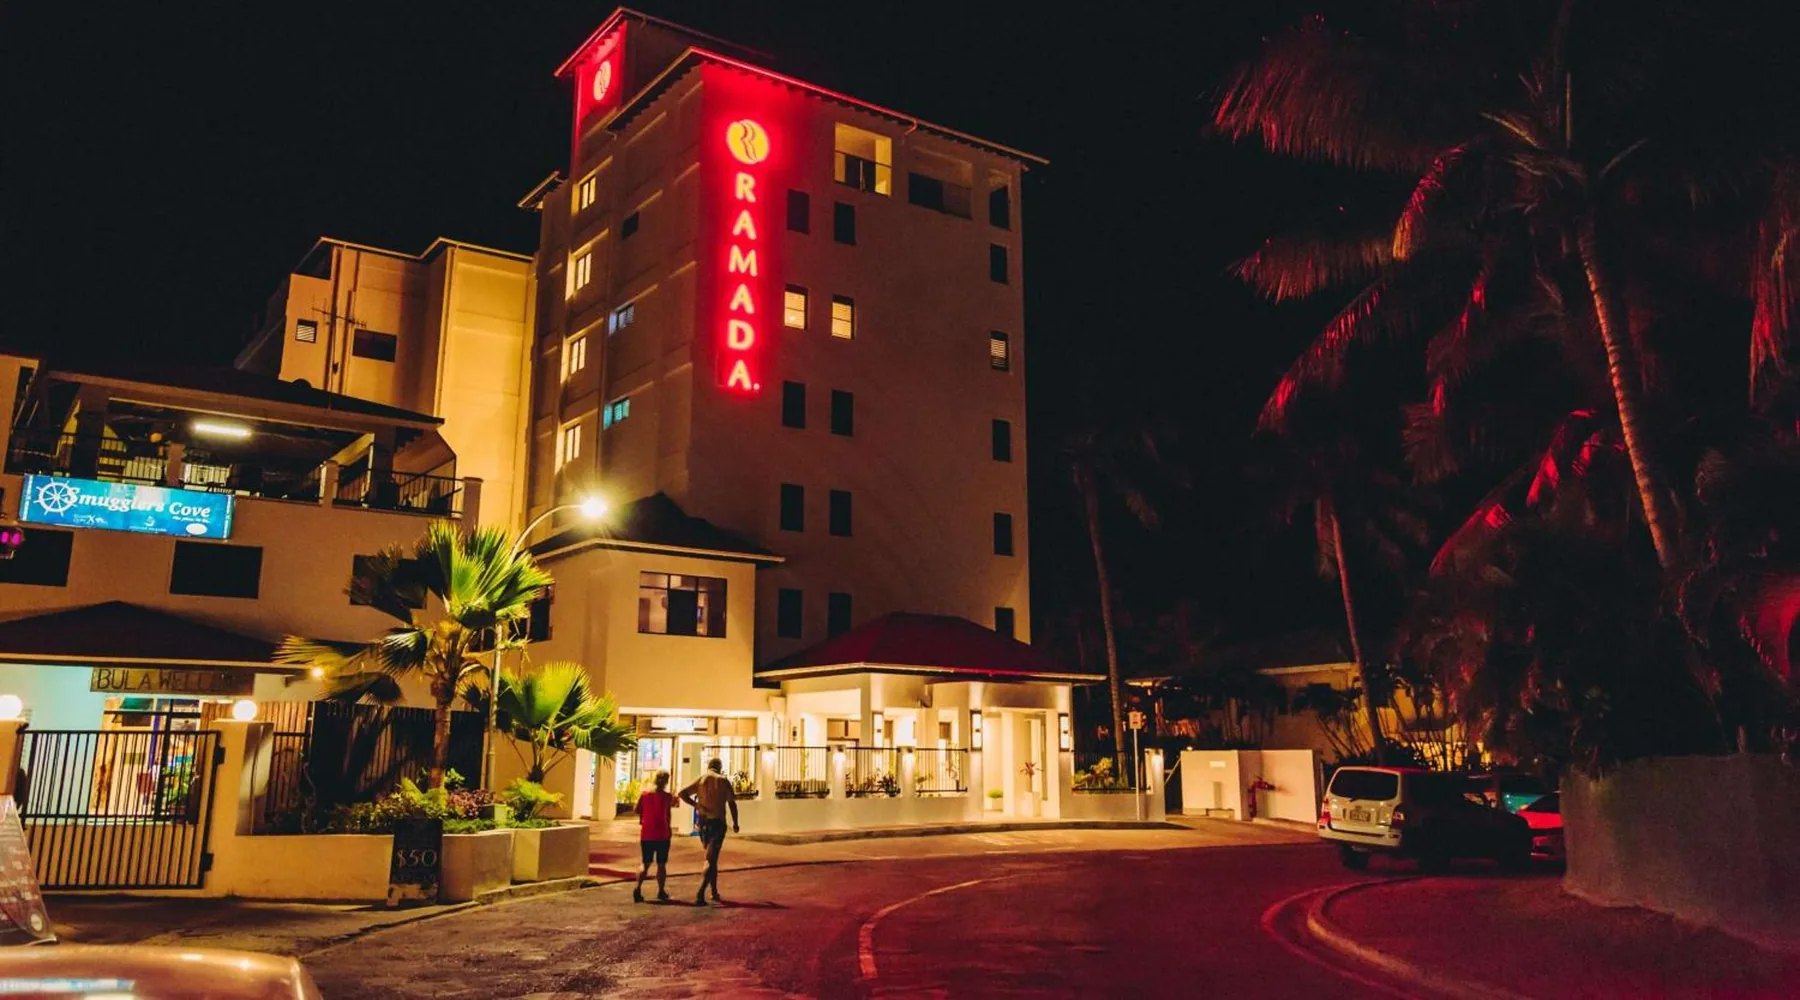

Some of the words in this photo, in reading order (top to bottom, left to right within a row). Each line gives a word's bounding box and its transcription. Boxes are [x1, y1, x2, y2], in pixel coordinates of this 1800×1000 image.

[63, 487, 165, 512] Smugglers
[168, 501, 211, 518] Cove
[97, 668, 152, 691] BULA
[397, 848, 438, 868] $50
